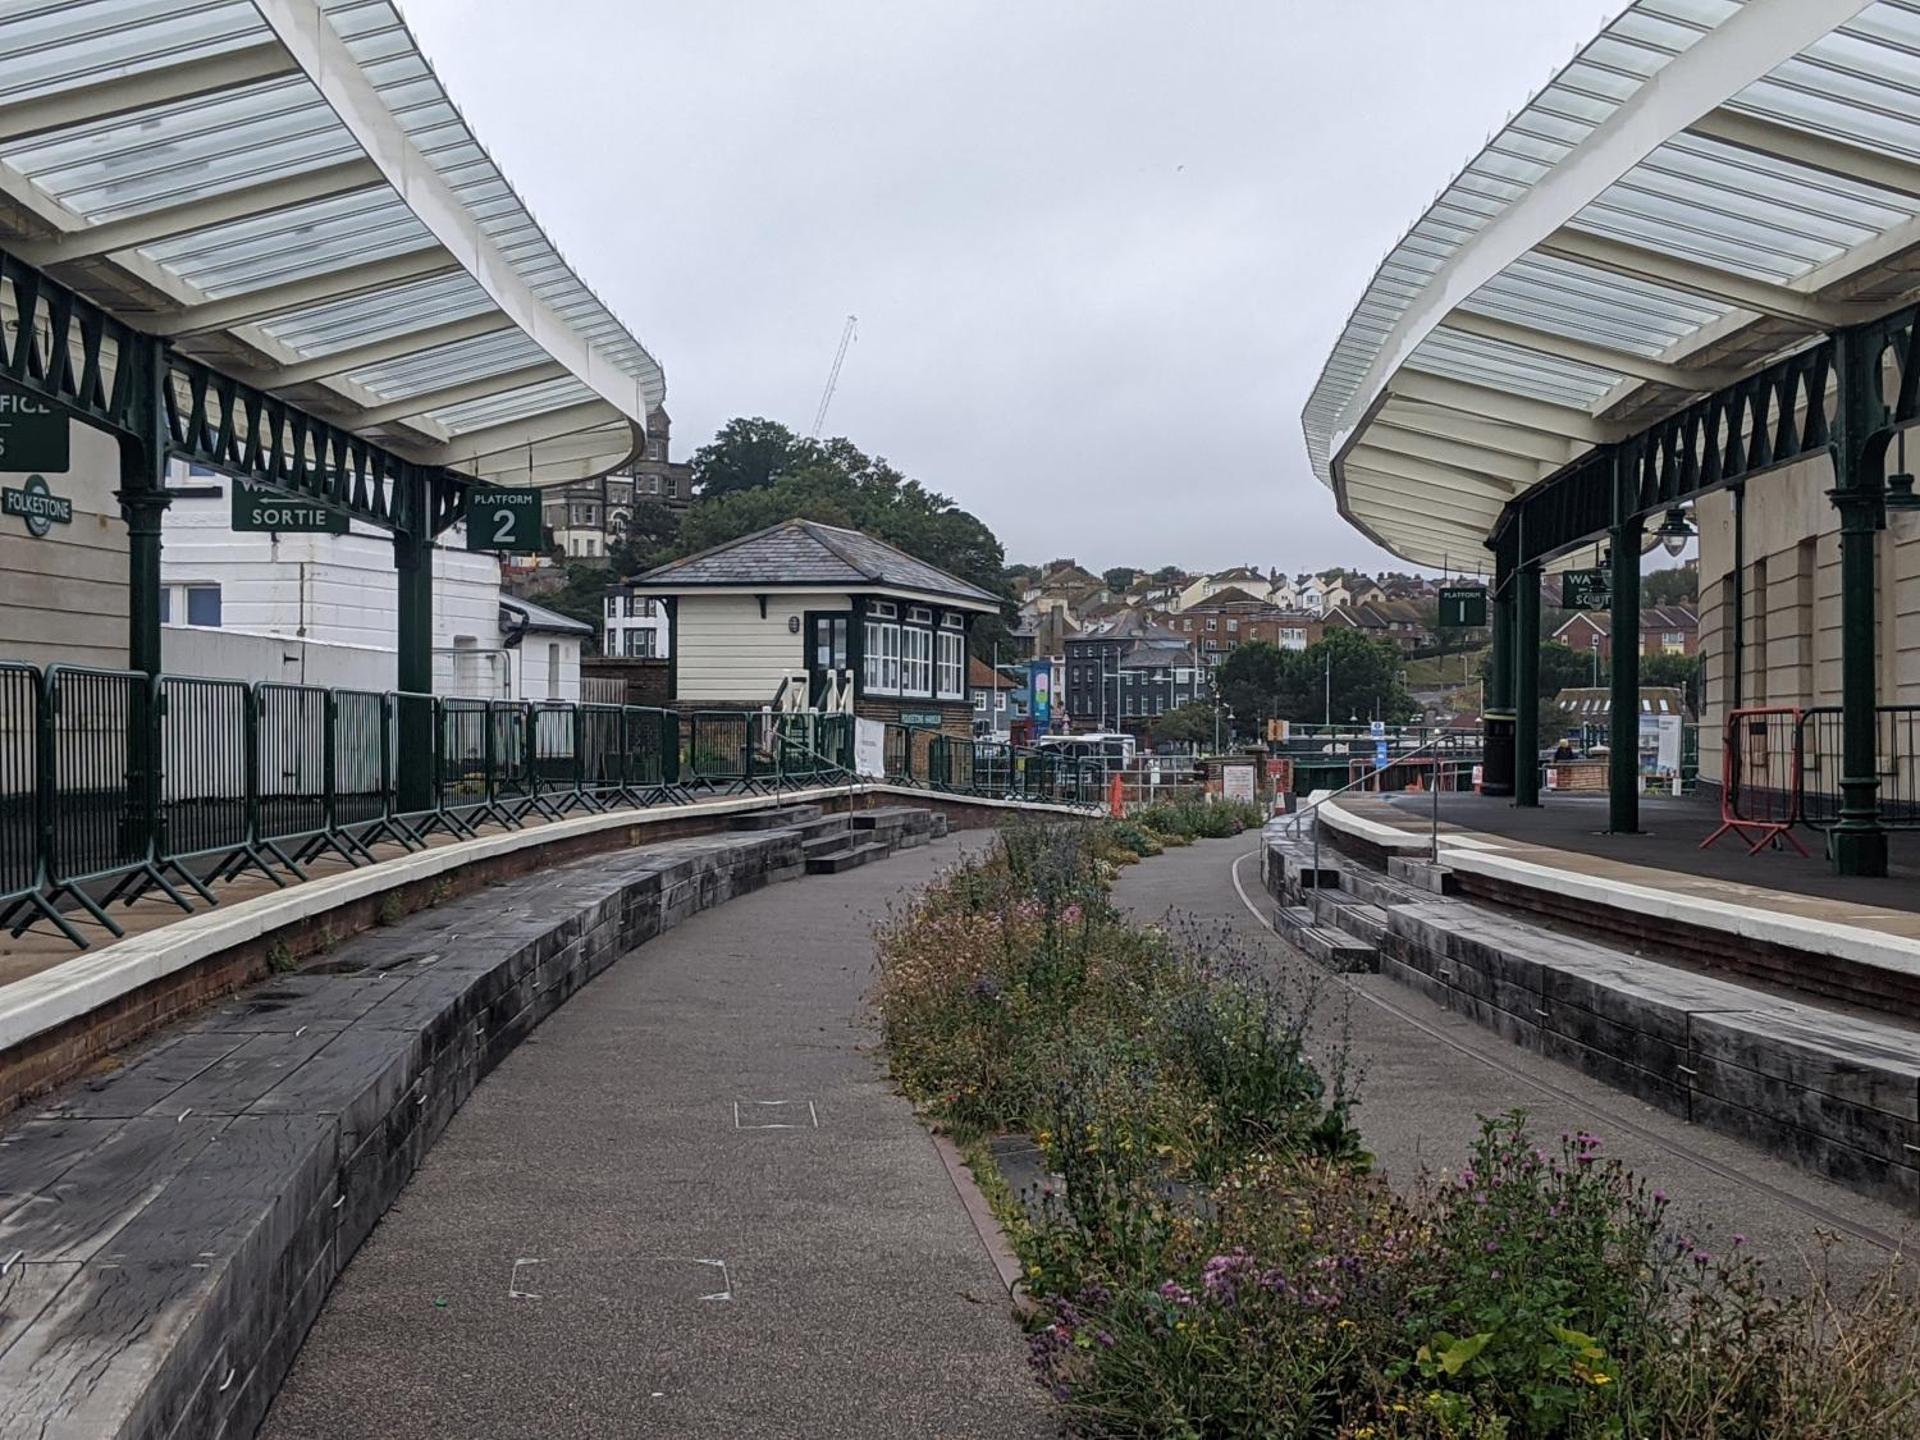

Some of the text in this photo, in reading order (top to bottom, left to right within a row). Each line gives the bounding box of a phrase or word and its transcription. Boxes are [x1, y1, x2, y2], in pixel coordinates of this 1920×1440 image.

[8, 491, 69, 519] FOLKESTONE
[474, 495, 532, 505] PLATFORM
[252, 509, 326, 525] SORTIE
[493, 510, 516, 542] 2
[1568, 574, 1592, 585] WA
